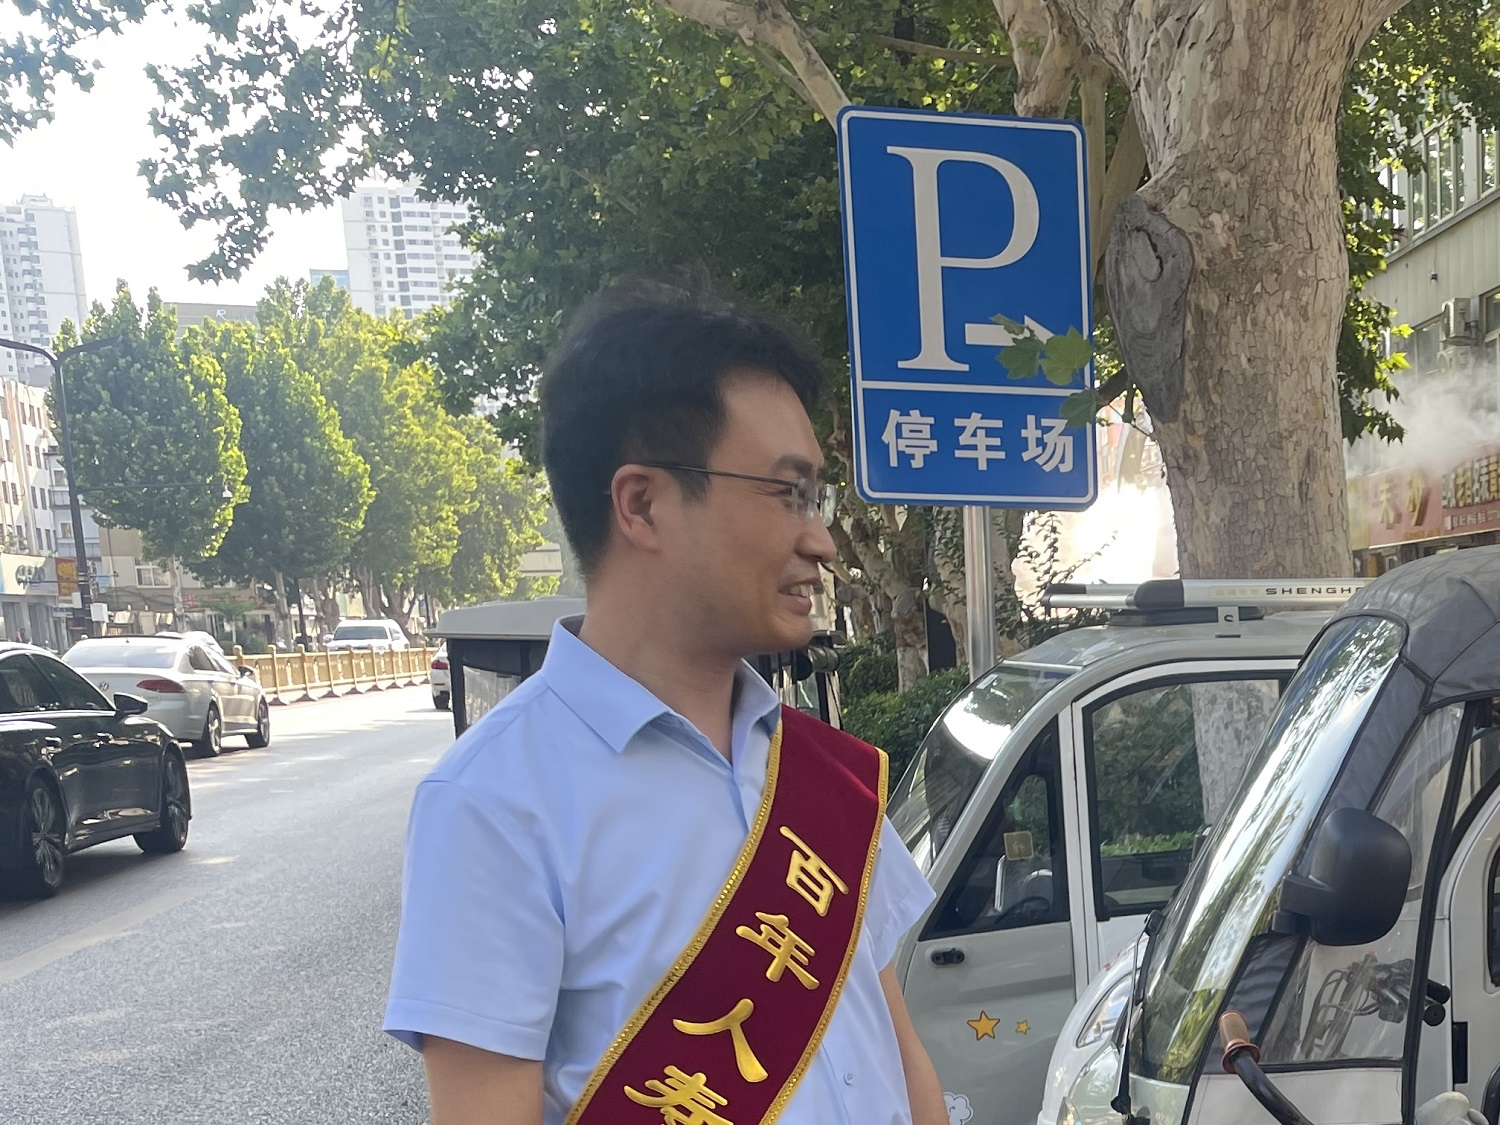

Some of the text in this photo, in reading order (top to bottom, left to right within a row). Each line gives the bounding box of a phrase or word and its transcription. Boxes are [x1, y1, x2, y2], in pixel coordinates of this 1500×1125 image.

[886, 145, 1040, 372] P
[881, 409, 1074, 474] 停车场
